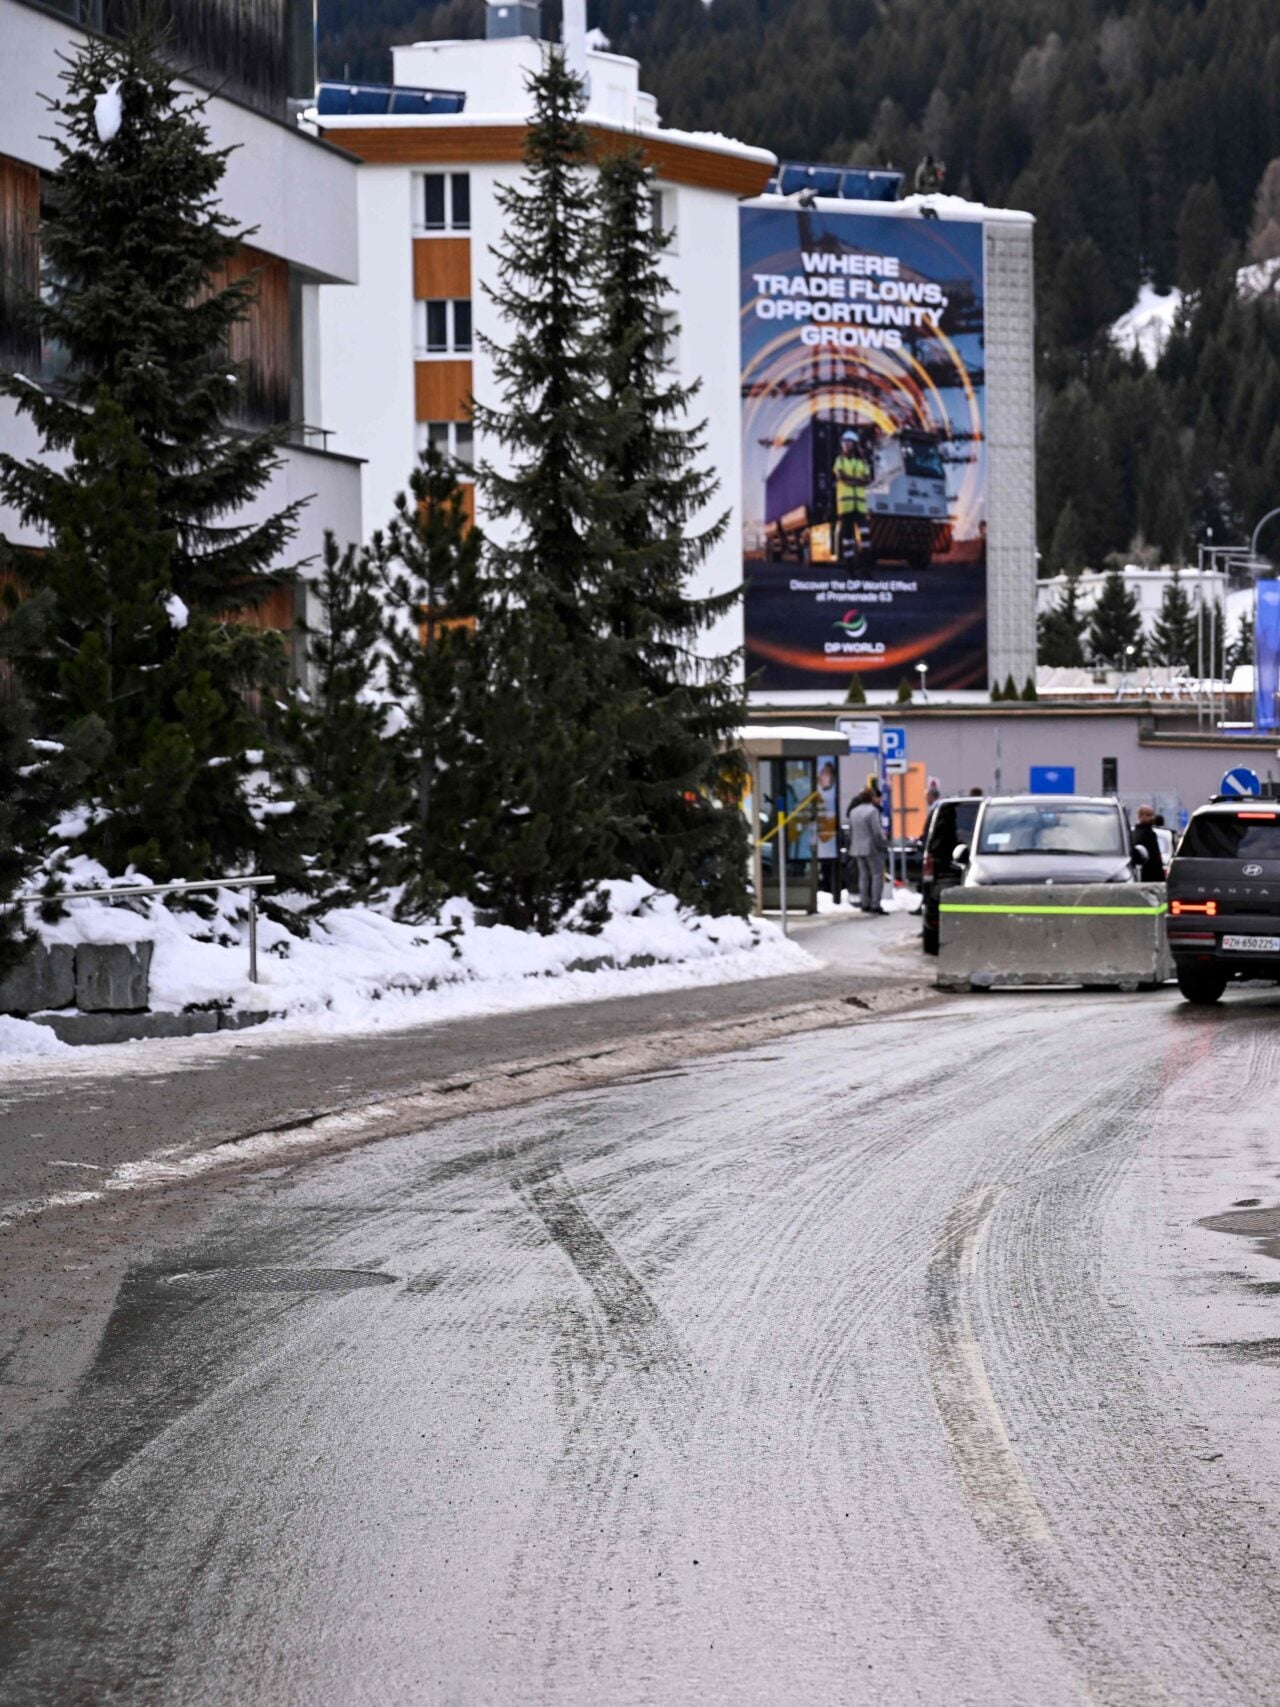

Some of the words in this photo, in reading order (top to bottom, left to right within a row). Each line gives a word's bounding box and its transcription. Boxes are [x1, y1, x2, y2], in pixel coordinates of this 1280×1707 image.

[801, 252, 900, 277] WHERE
[752, 273, 845, 298] TRADE
[850, 279, 949, 306] FLOWS,
[755, 299, 944, 327] OPPORTUNITY
[800, 325, 903, 348] GROWS
[790, 579, 829, 590] Discover
[831, 580, 846, 590] the
[846, 580, 860, 590] DP
[862, 581, 888, 591] World
[889, 581, 917, 591] Effect
[815, 592, 826, 602] at
[827, 591, 878, 602] Promenade
[824, 642, 840, 653] DP
[842, 642, 886, 653] WORLD
[883, 732, 899, 755] P
[1197, 886, 1269, 895] SANTA
